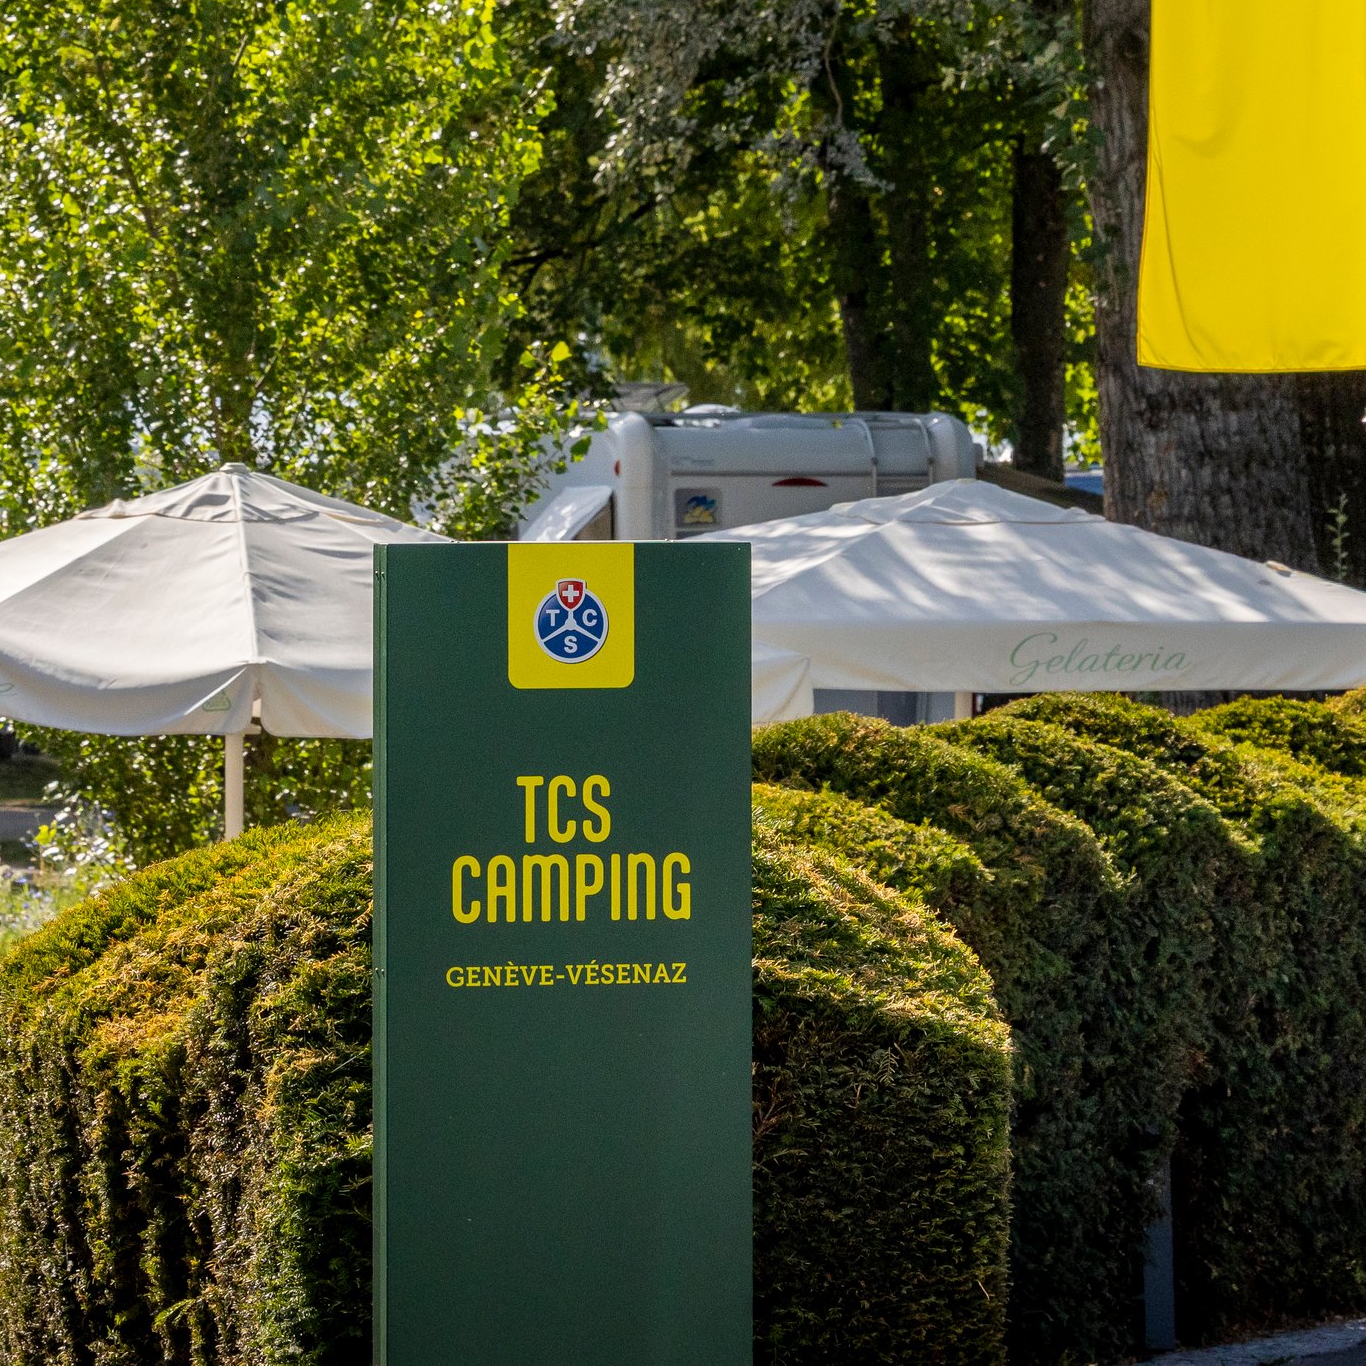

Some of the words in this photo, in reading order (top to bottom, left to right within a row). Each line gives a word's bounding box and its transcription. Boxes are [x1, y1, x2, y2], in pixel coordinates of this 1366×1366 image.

[1009, 632, 1192, 685] Gelateria
[516, 774, 611, 844] TCS
[451, 851, 692, 924] CAMPING
[445, 960, 688, 988] GENÈVE-VÉSENAZ
